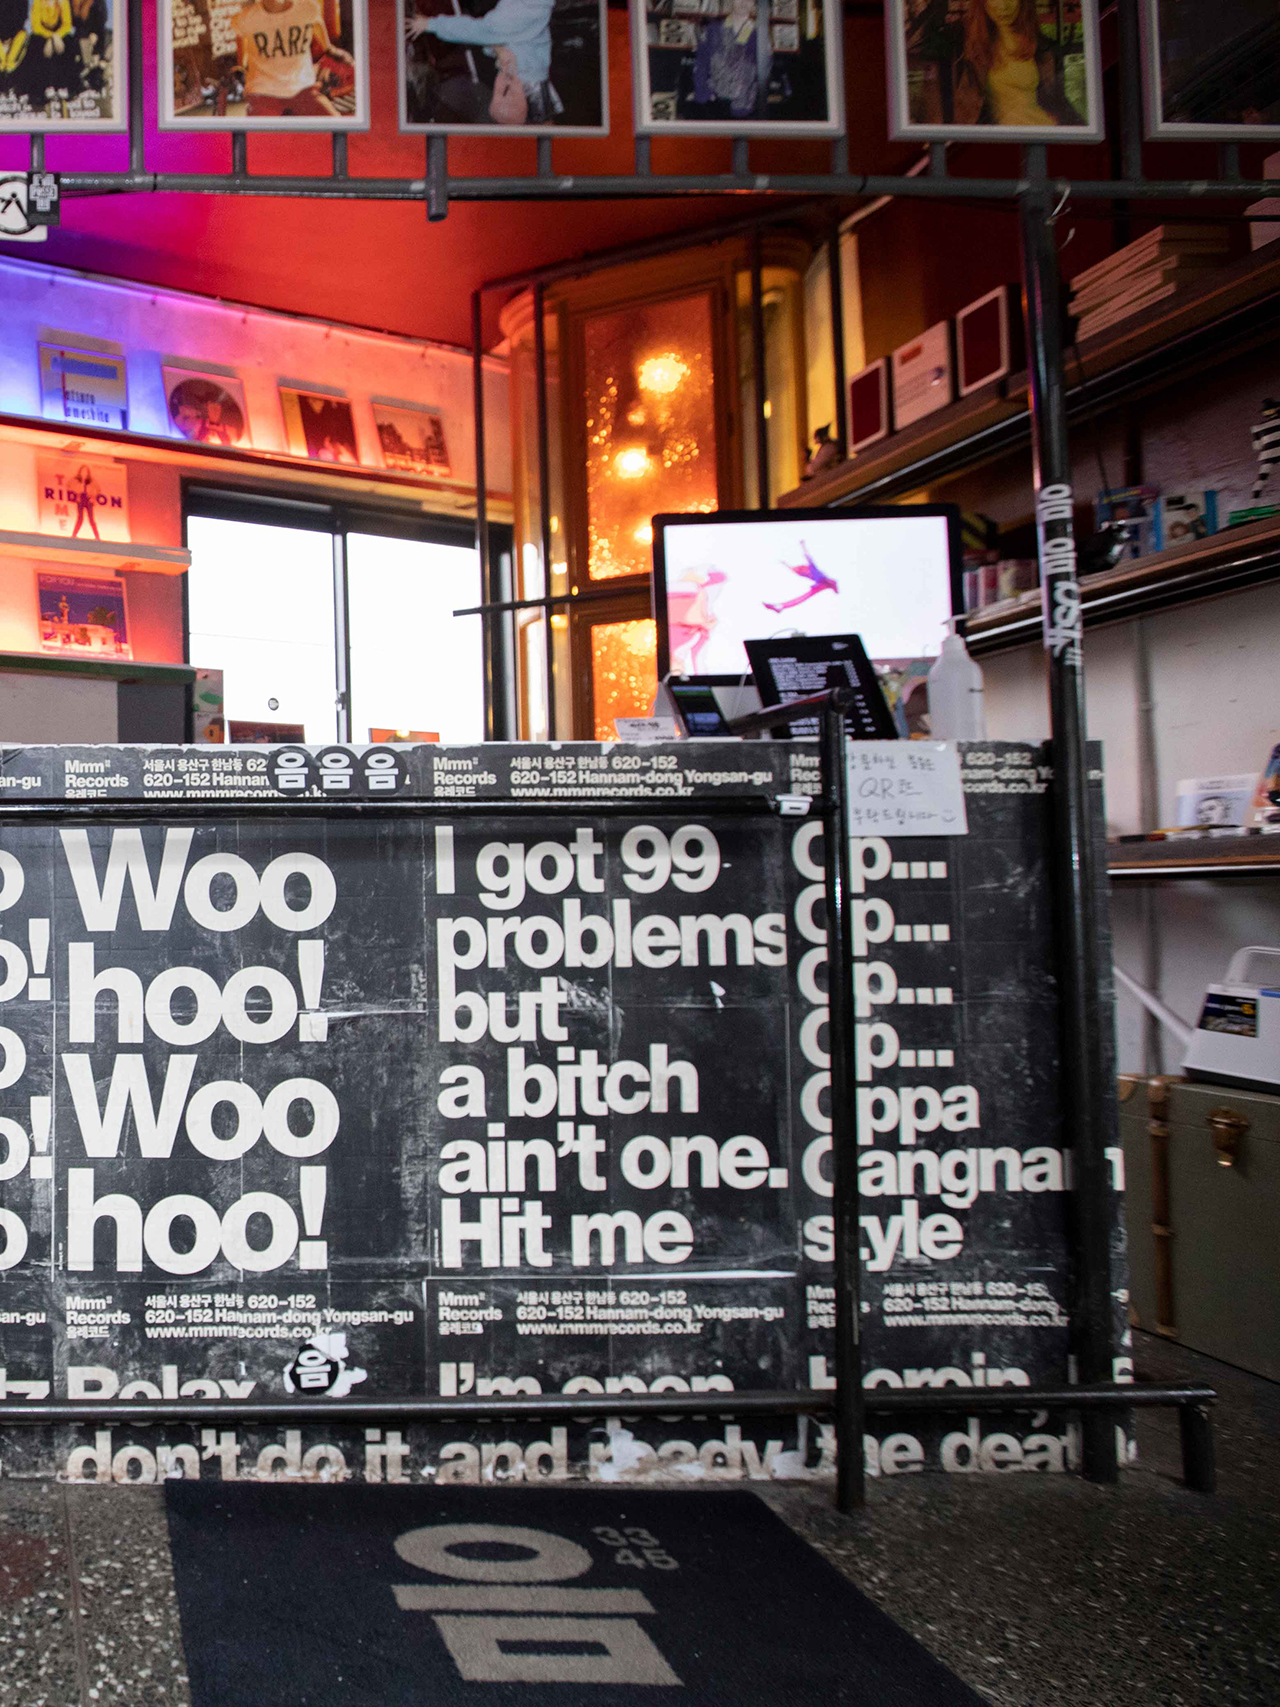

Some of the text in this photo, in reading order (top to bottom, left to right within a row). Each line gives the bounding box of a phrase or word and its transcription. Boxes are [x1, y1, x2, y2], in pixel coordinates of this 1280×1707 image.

[96, 492, 122, 508] ON
[143, 759, 175, 771] 서울시
[177, 759, 209, 771] 용산구
[211, 758, 243, 771] 한남동
[510, 756, 542, 769] 서울시
[544, 756, 575, 769] 용산구
[611, 756, 677, 769] 620-152
[65, 774, 129, 788] Records
[143, 773, 210, 786] 620-152
[433, 770, 497, 785] Records
[510, 771, 577, 784] 620-152
[578, 770, 683, 789] Hannam-dong
[684, 769, 773, 788] Yongsan-gu
[435, 824, 721, 911] I got 99
[59, 828, 337, 932] Woo
[436, 898, 788, 985] problems
[68, 939, 328, 1046] hoo!
[438, 976, 569, 1043] but
[437, 1043, 699, 1119] a bitch
[61, 1053, 340, 1161] Woo
[437, 1121, 789, 1194] ain't one.
[67, 1166, 328, 1275] hoo!
[441, 1197, 553, 1268] Hit
[571, 1209, 694, 1266] me
[803, 1200, 964, 1272] syle
[145, 1295, 177, 1308] 서울시
[179, 1295, 212, 1308] 용산구
[248, 1294, 316, 1309] 620-152
[619, 1291, 687, 1305] 620-152
[883, 1298, 950, 1313] 620-152
[66, 1311, 131, 1325] Records
[145, 1309, 414, 1330] 620-152 Hannam-dong Yongsan-gu
[438, 1307, 503, 1322] Records
[516, 1305, 785, 1324] 620-152 Hannam-dong Yongsan-gu
[66, 1326, 110, 1339] 음레코드
[145, 1324, 332, 1340] www.mmmrecords.co.kr
[516, 1321, 703, 1336] www.mmmrecords.co.kr
[67, 1428, 411, 1484] don't do it
[438, 1426, 568, 1484] and
[592, 1525, 661, 1548] 33
[614, 1548, 681, 1572] 45
